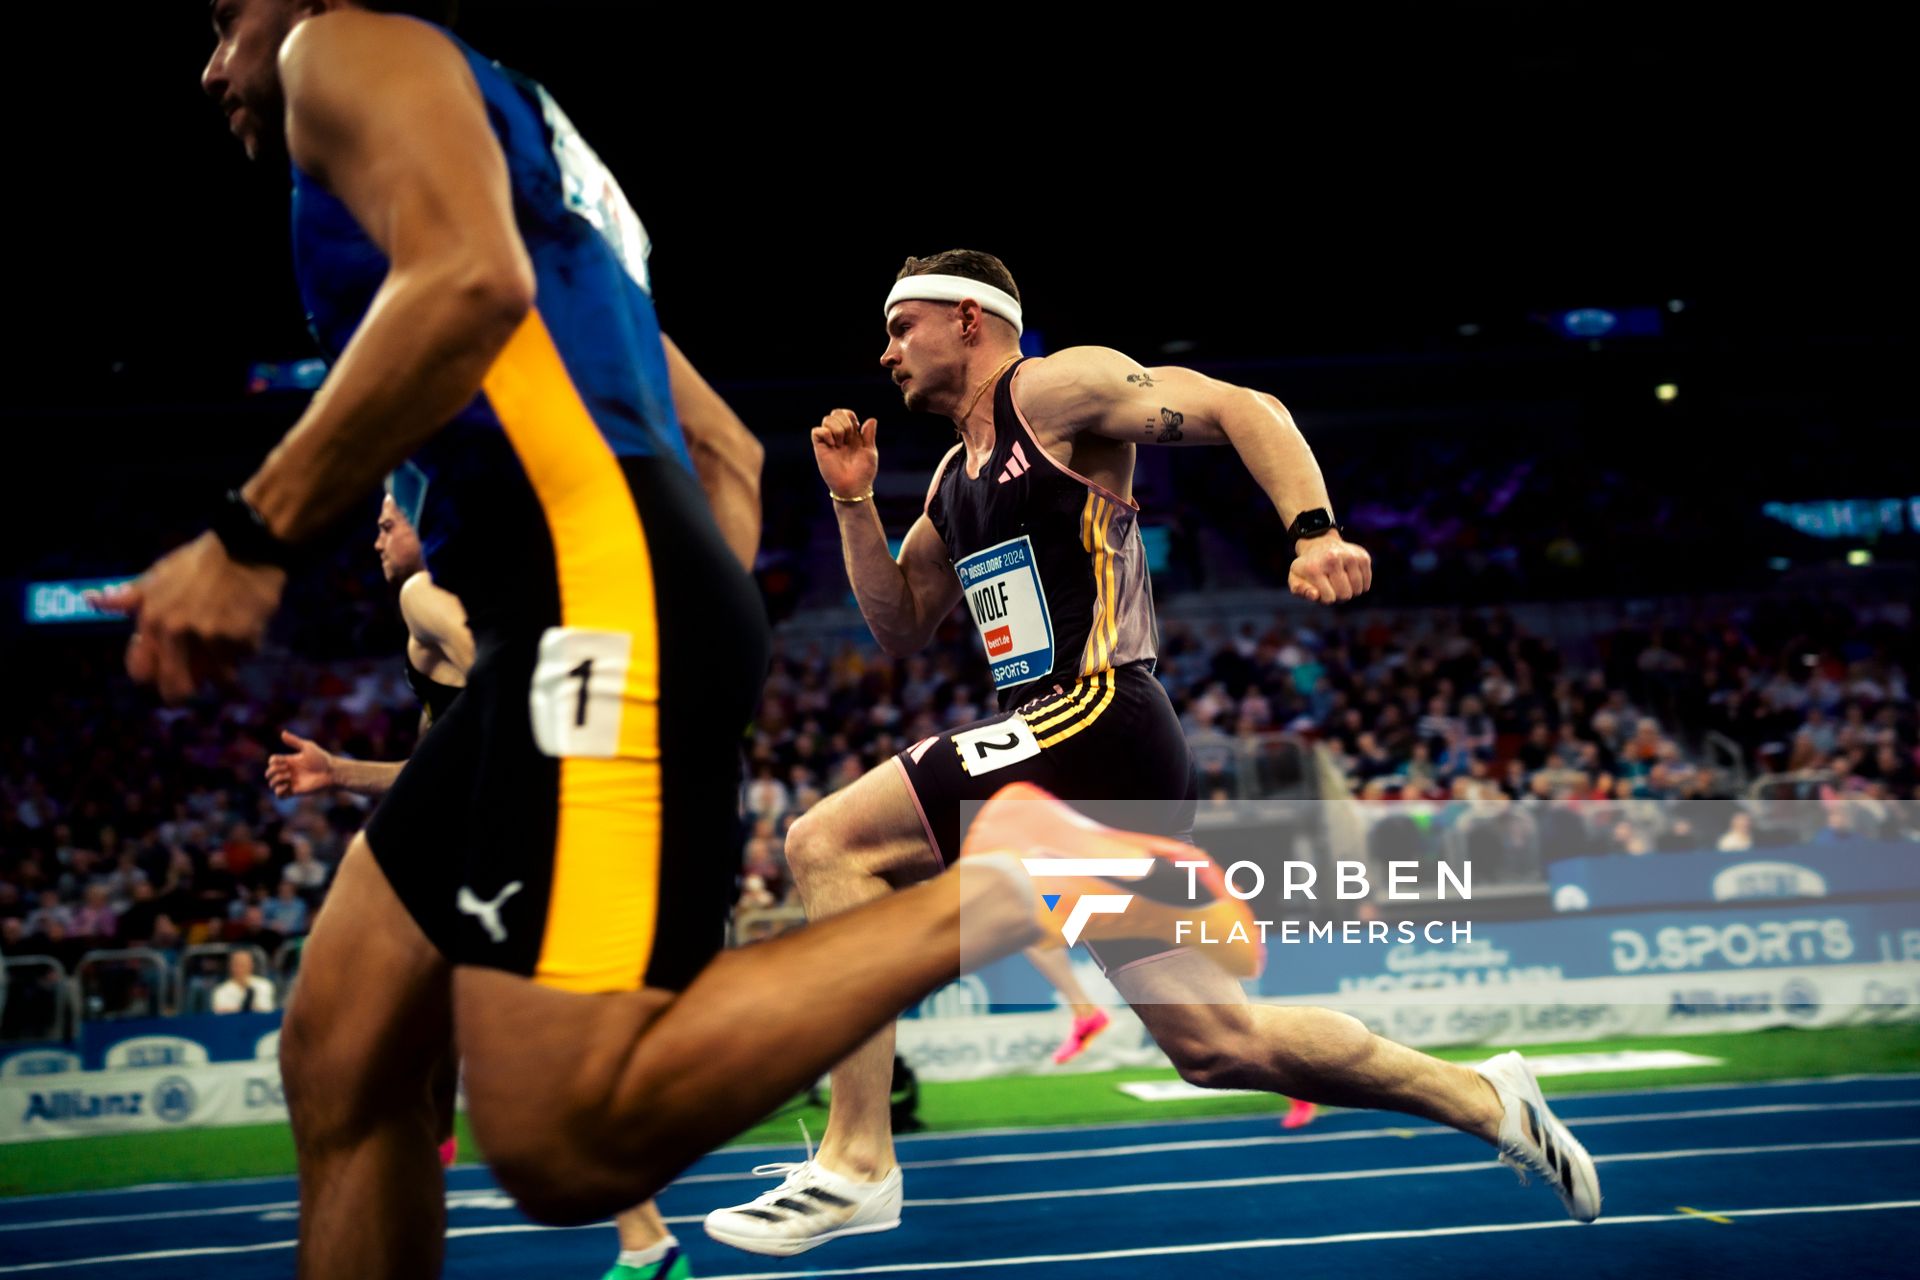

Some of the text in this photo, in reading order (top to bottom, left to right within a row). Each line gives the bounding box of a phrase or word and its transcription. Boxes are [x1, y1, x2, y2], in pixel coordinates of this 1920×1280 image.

[968, 548, 1025, 579] DÜSSELDORF 2024
[972, 581, 1009, 625] WOLF
[569, 658, 594, 727] 1
[975, 732, 1020, 759] 2
[1609, 918, 1855, 972] D.SPORTS
[1669, 989, 1773, 1019] Allianz
[23, 1087, 144, 1124] Allianz
